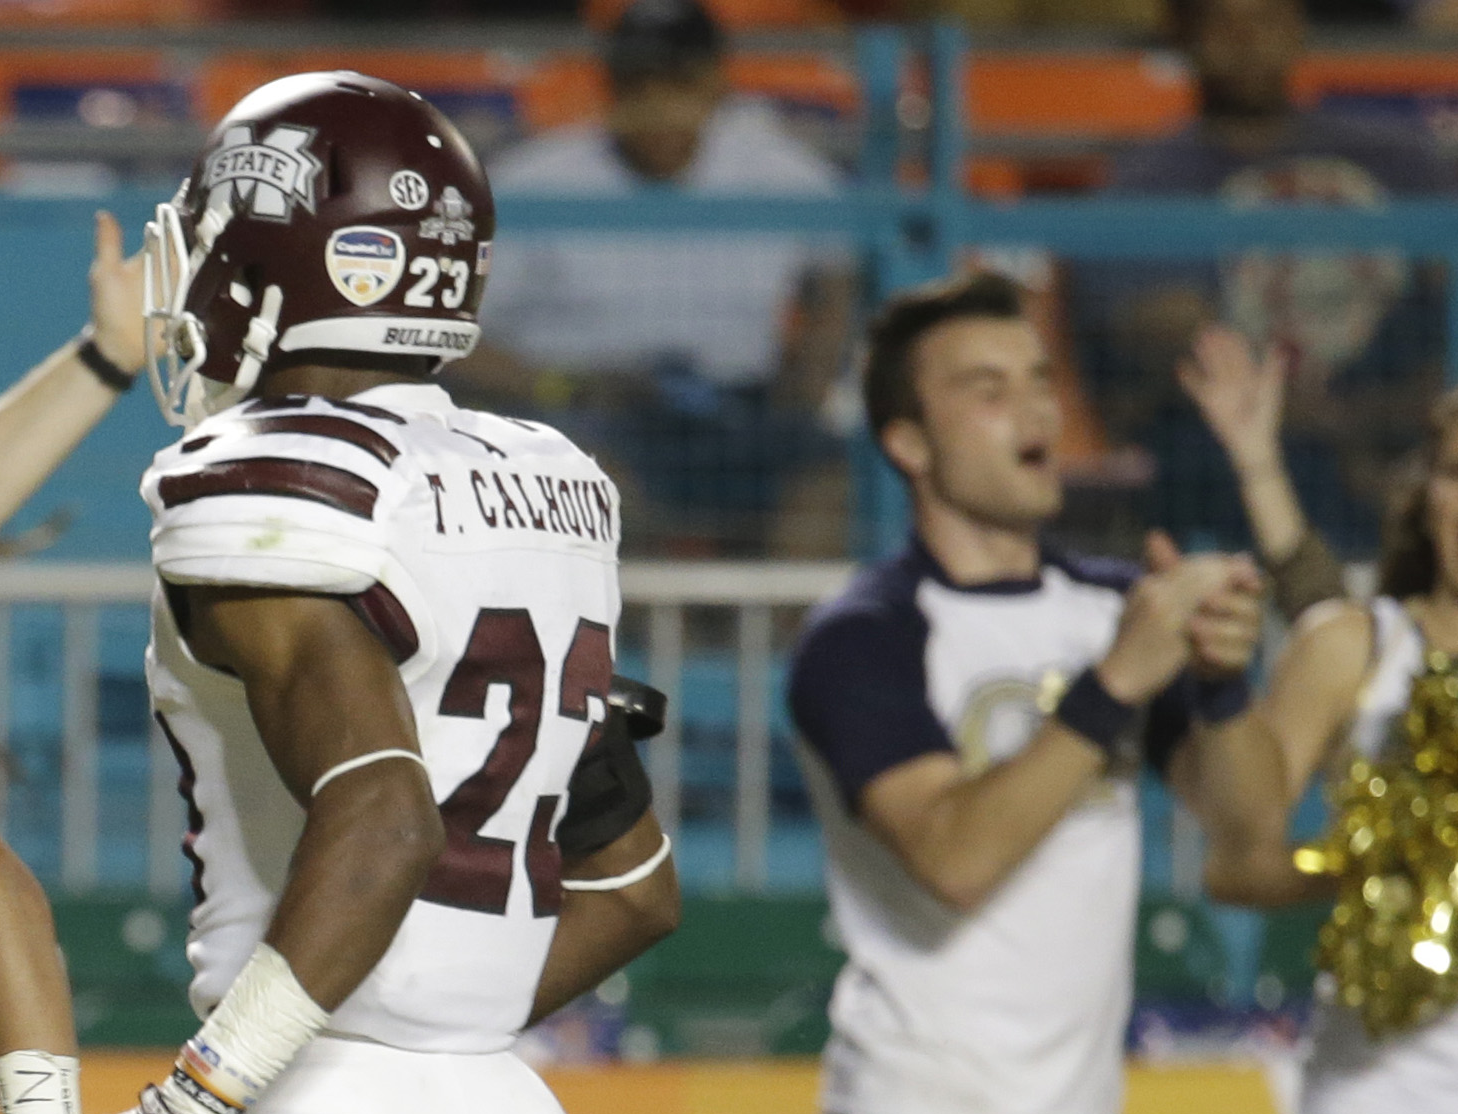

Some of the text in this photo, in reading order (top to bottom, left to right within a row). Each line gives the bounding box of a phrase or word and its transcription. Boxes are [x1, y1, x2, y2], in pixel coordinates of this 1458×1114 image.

[214, 151, 288, 182] STATE
[393, 172, 425, 206] SEC
[403, 255, 470, 309] 23
[470, 469, 616, 543] CALHOUN
